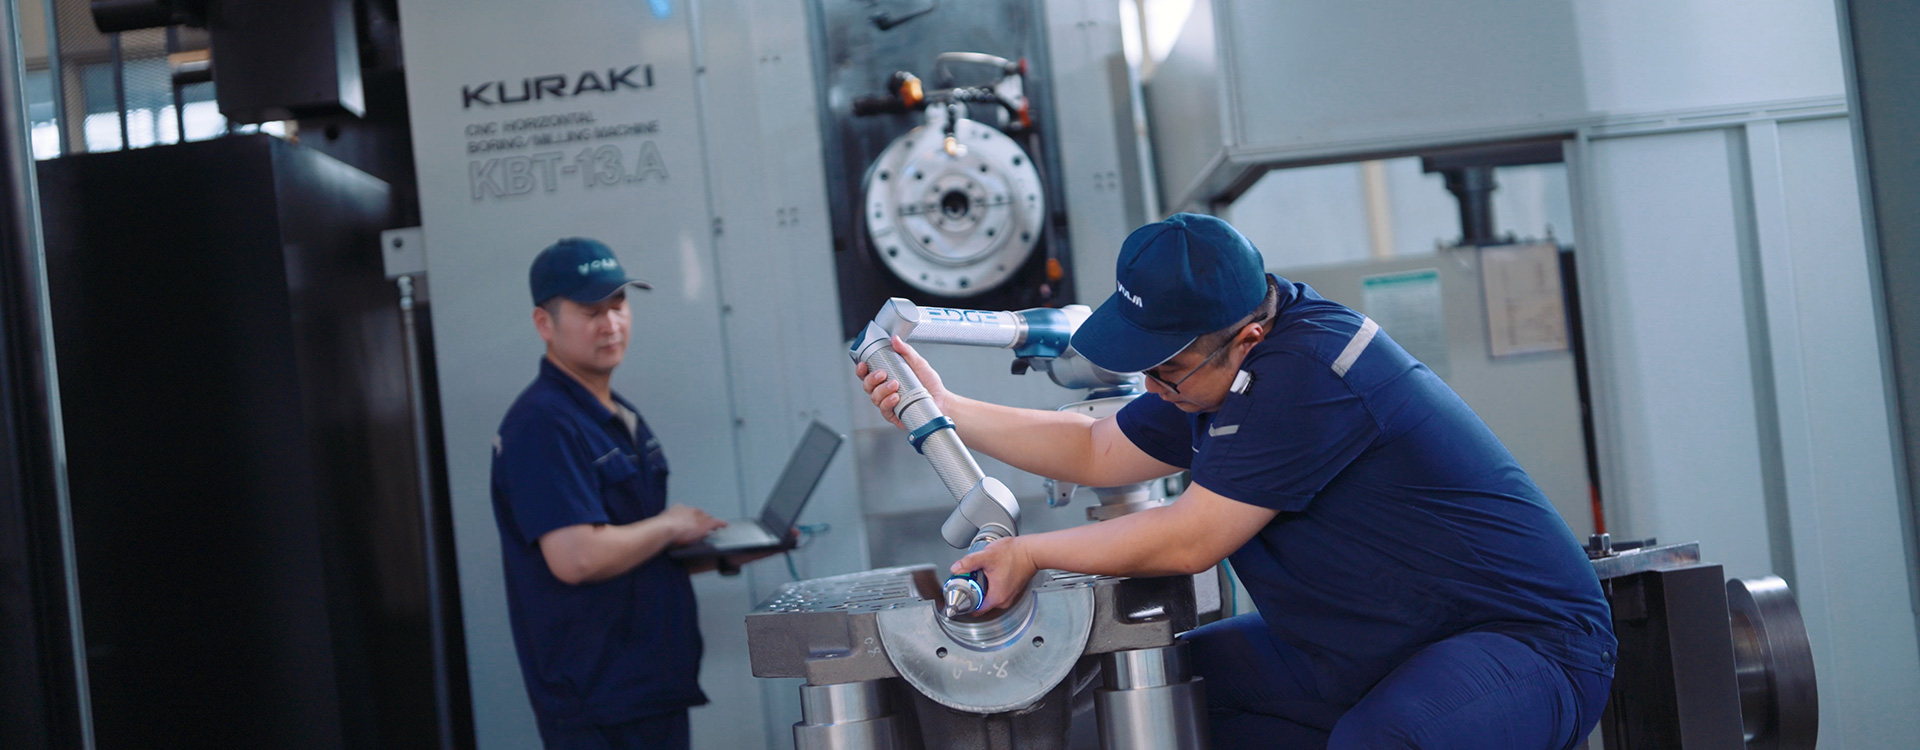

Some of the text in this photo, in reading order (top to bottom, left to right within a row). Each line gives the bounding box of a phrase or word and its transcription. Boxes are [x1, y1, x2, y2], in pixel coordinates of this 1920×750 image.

[462, 64, 654, 108] KURAKI
[465, 111, 596, 135] CNC HORIZONTAL
[926, 307, 1000, 325] EDGE
